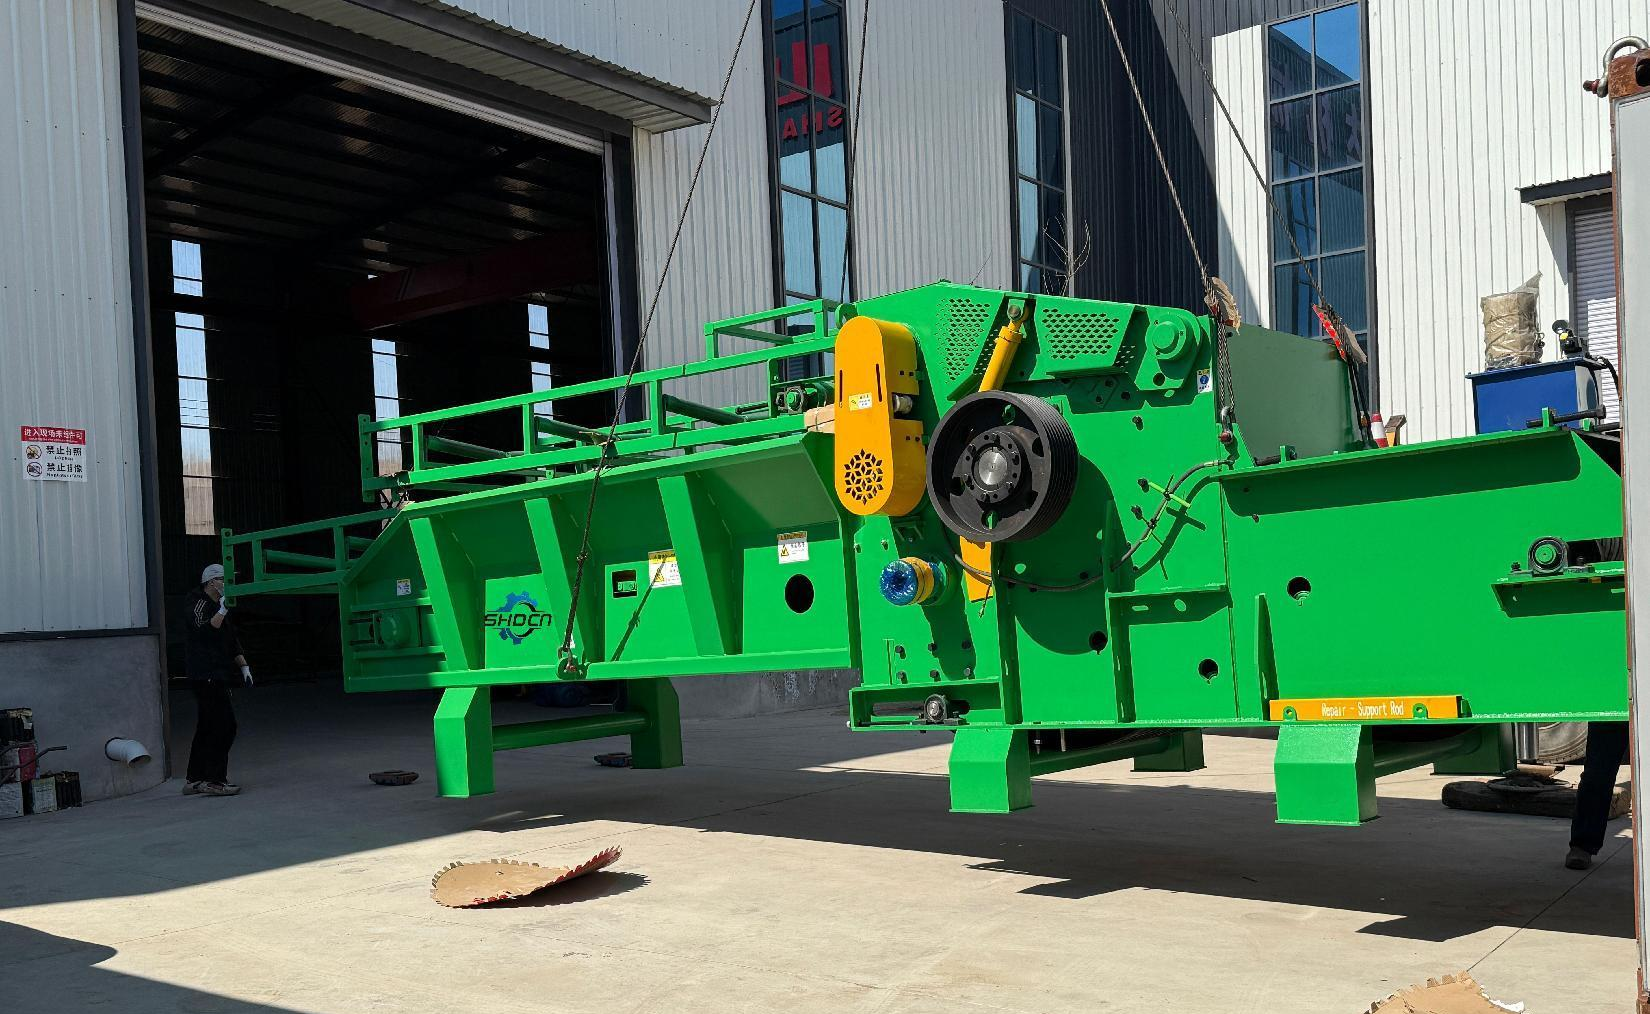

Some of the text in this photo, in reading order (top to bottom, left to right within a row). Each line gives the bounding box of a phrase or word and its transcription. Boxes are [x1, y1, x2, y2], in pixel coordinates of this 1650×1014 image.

[1321, 702, 1346, 718] Repair
[1357, 701, 1388, 719] Support
[1390, 701, 1404, 716] Rod
